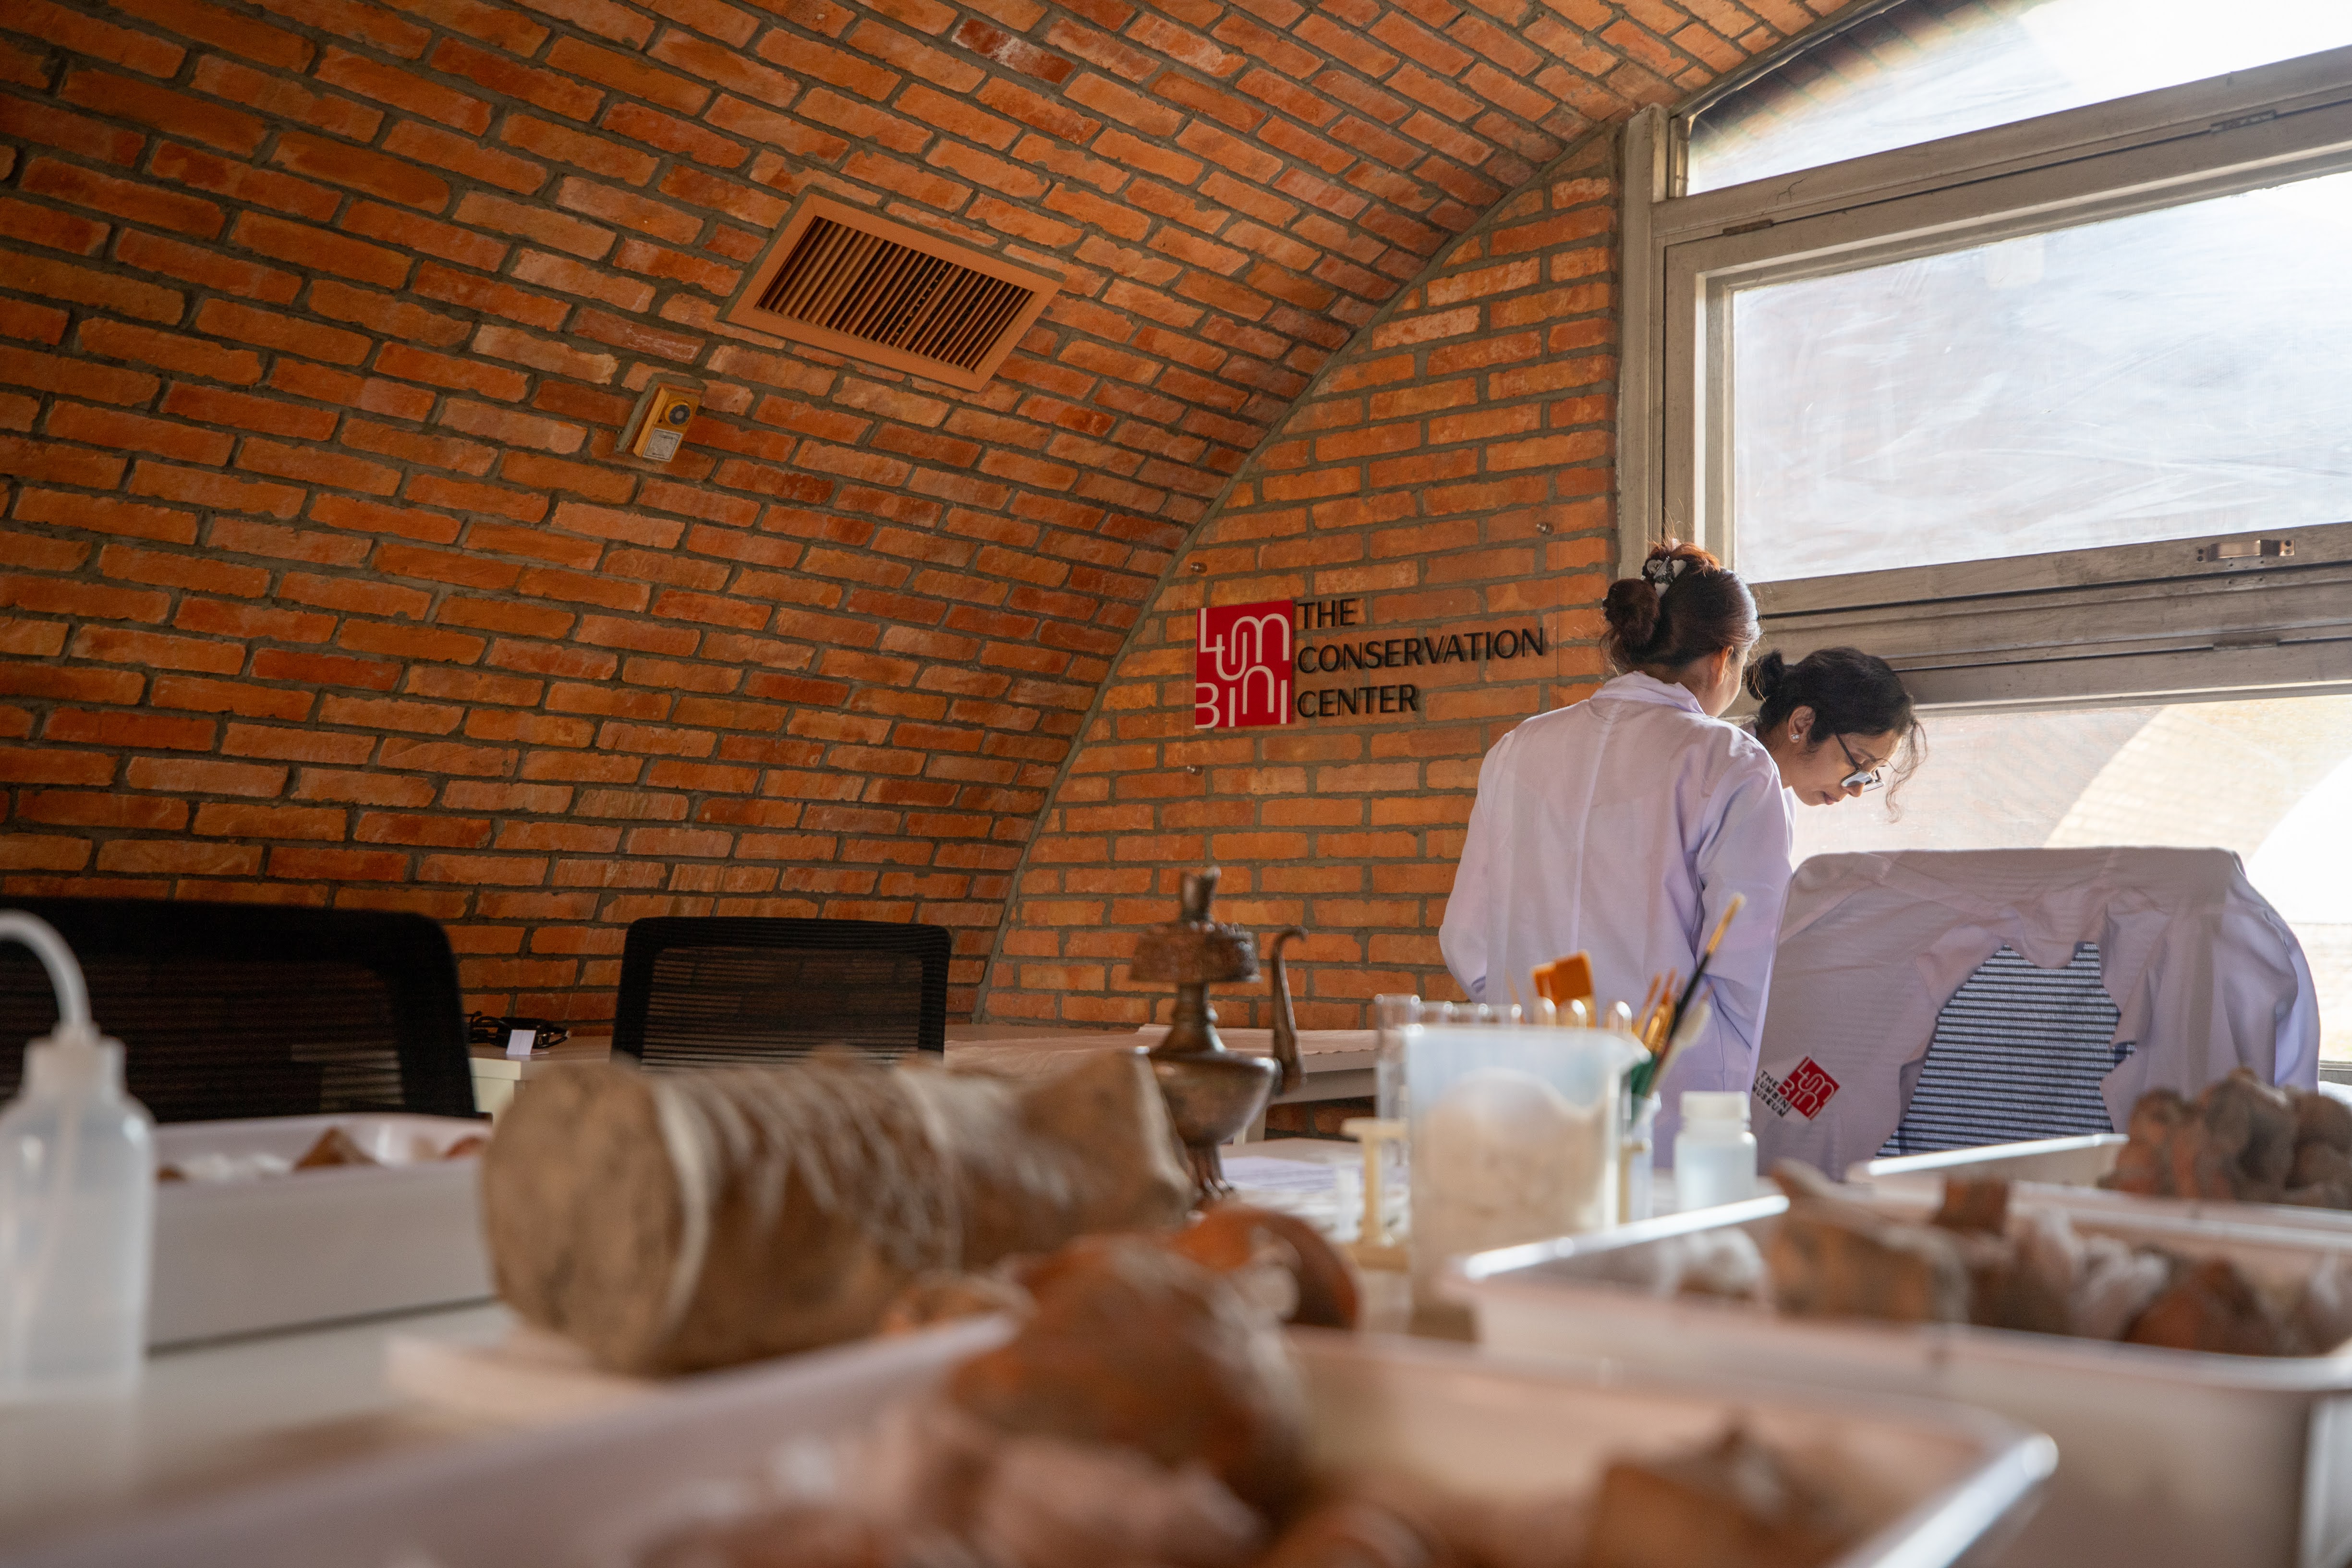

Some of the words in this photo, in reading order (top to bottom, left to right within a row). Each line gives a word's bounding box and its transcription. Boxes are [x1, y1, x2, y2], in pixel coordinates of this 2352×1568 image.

[1297, 598, 1356, 629] THE
[1297, 627, 1544, 673] CONSERVATION
[1297, 684, 1418, 718] CENTER
[1761, 1069, 1779, 1088] THE
